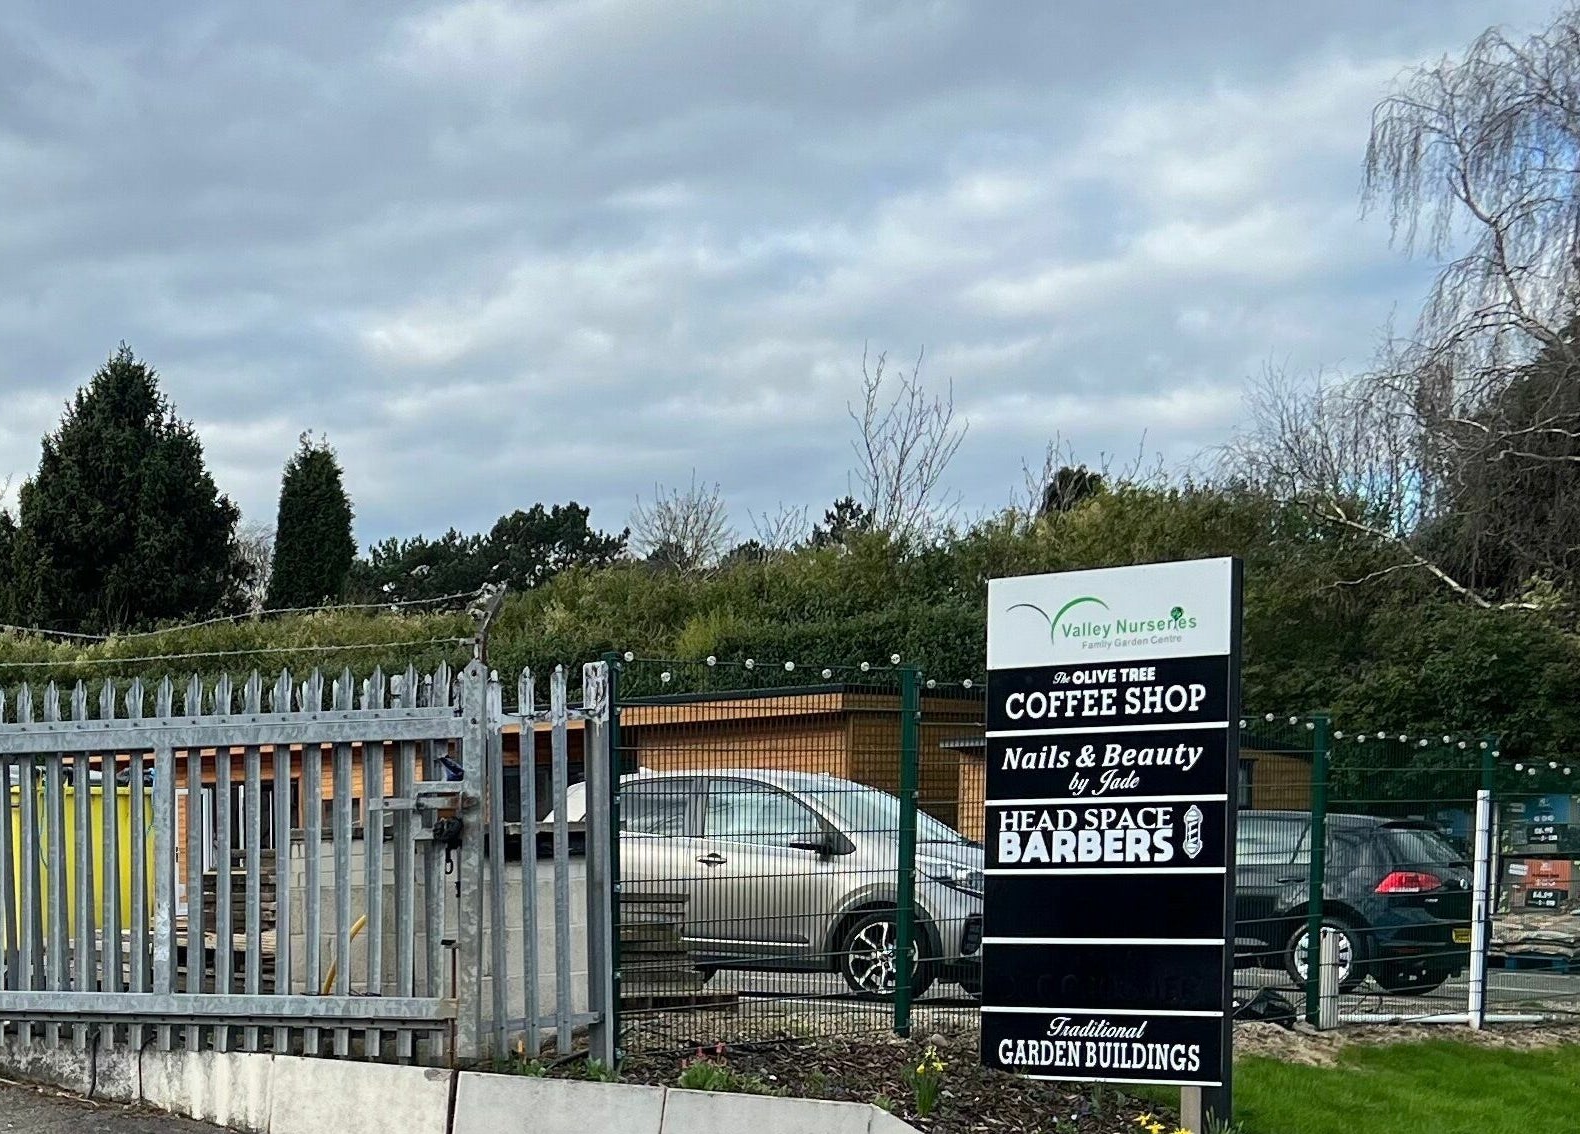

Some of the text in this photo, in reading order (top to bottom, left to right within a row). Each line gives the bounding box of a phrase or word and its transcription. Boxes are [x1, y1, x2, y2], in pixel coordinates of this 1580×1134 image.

[1062, 614, 1197, 639] Valley Nurseries
[1082, 634, 1182, 650] Family Garden Centre
[1053, 667, 1156, 684] The OLIVE TREE
[1005, 684, 1206, 720] COFFEE SHOP
[1001, 743, 1203, 772] Nails & Beauty
[1068, 769, 1140, 796] by Jade
[999, 806, 1173, 832] HEAD SPACE
[998, 829, 1174, 863] BARBERS
[1046, 1016, 1148, 1039] Traditional
[998, 1039, 1200, 1072] GARDEN BUILDINGS
